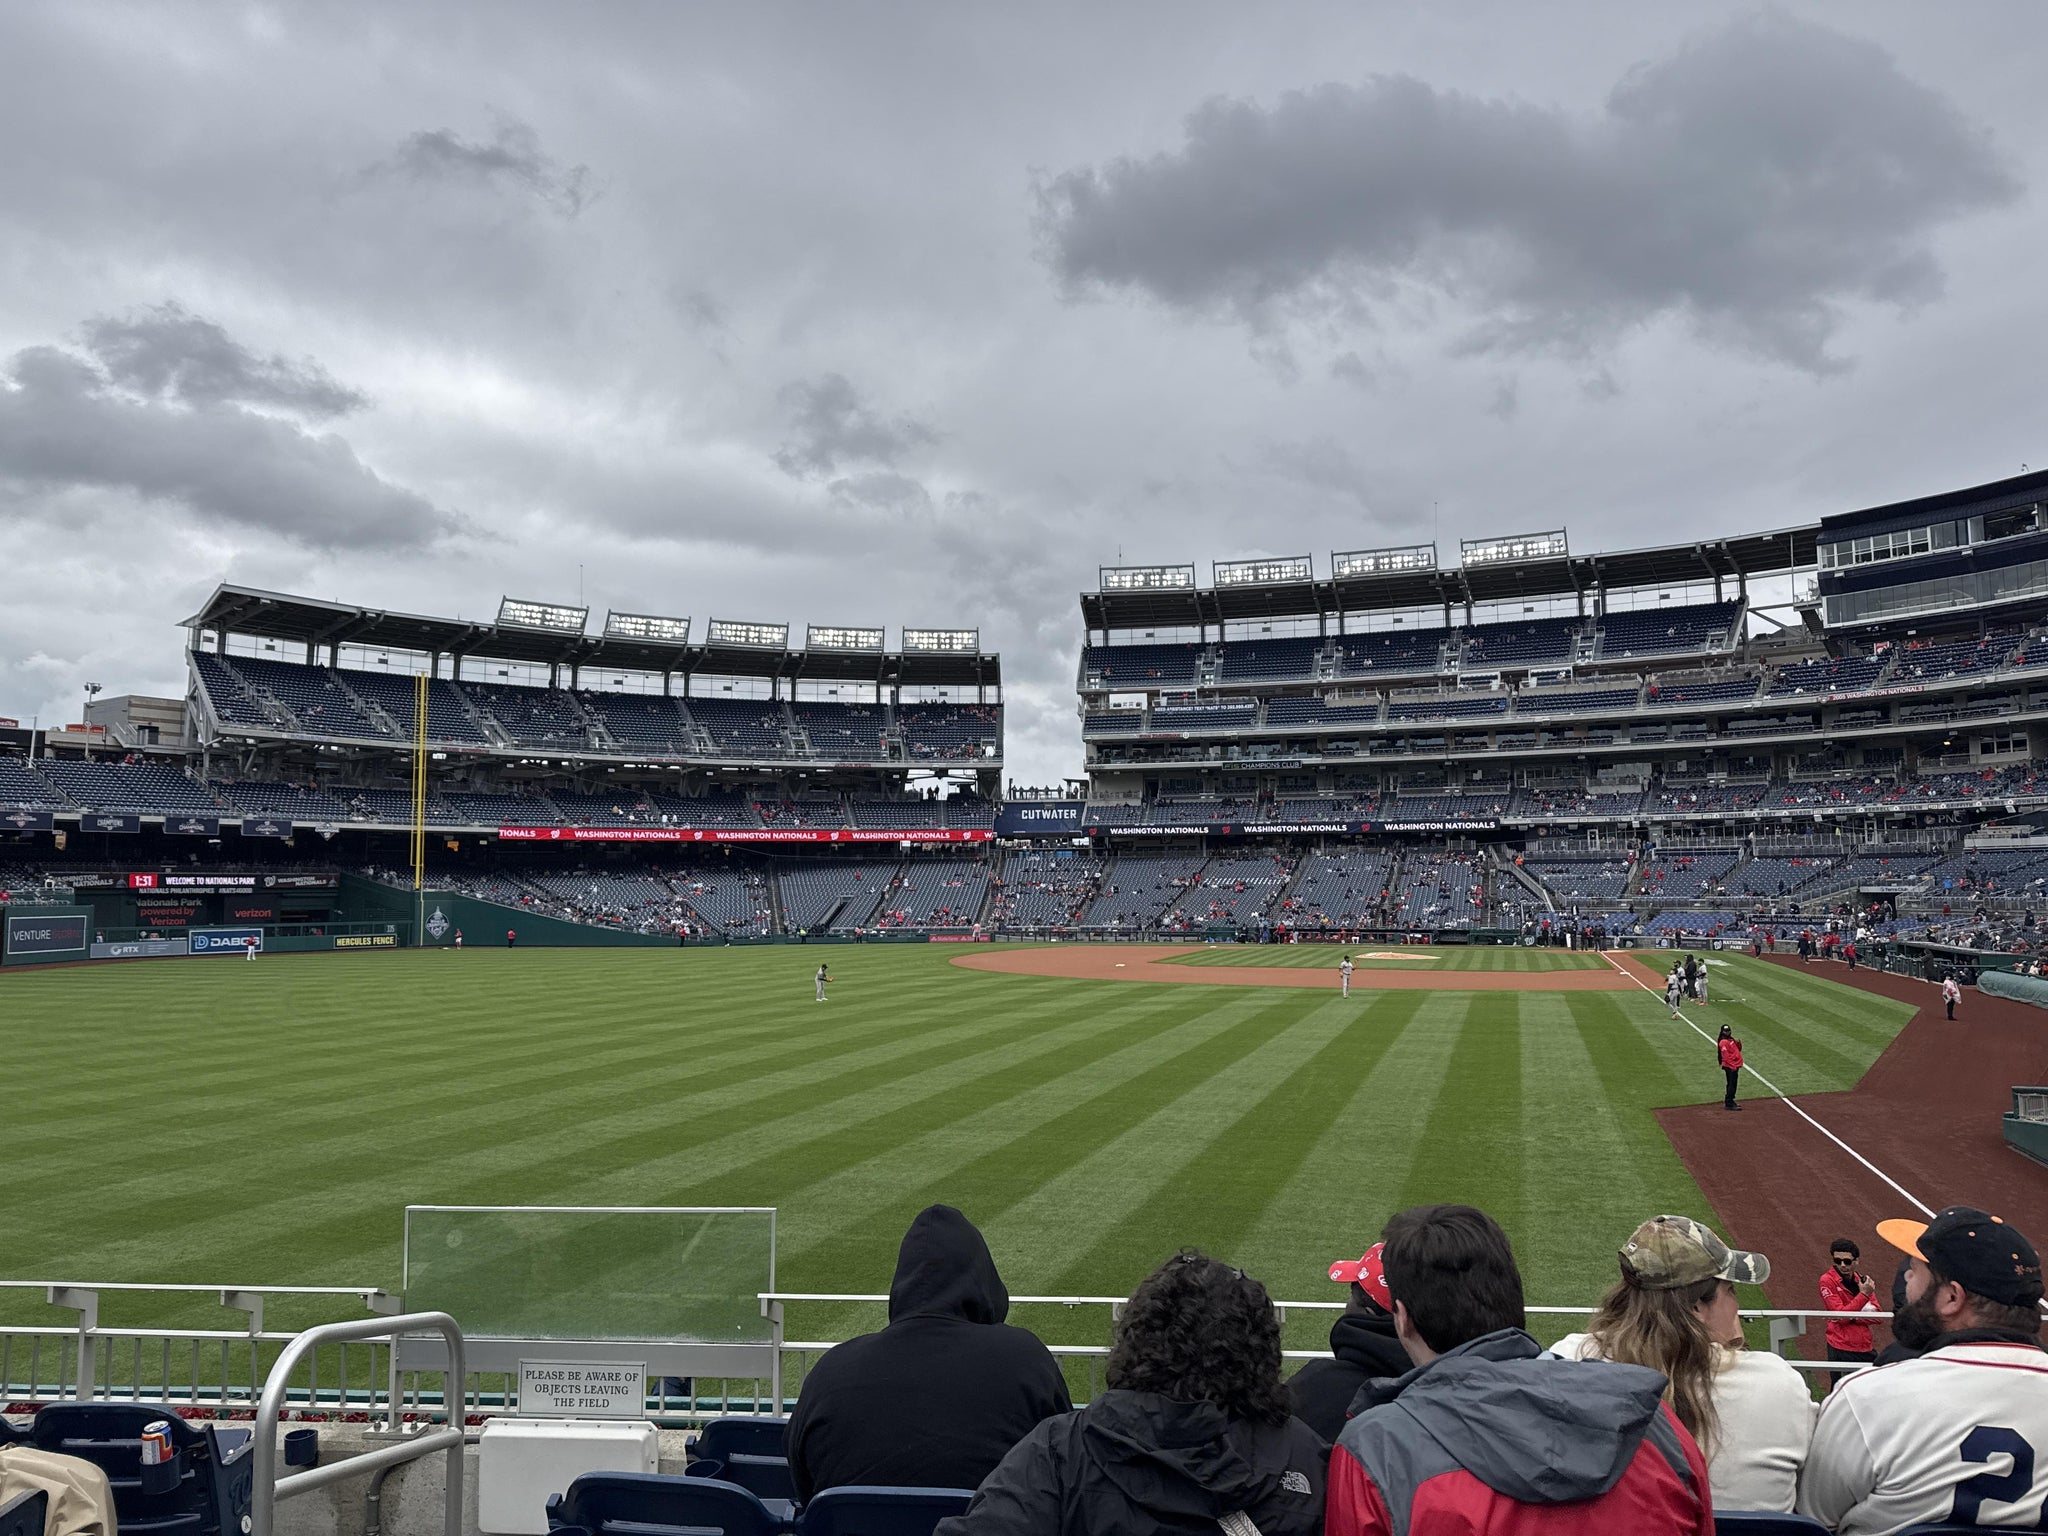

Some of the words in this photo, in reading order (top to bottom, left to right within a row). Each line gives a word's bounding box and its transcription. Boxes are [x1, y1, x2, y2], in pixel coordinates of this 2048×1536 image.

[1846, 690, 1888, 699] WASHINGTON
[1888, 686, 1923, 694] NATIONALS
[1021, 809, 1077, 820] CUTWATER
[1938, 814, 1962, 823] PNC
[1244, 825, 1298, 833] WASHINGTON
[1300, 824, 1347, 832] NATIONALS
[1384, 822, 1444, 831] WASHINGTON
[1445, 821, 1496, 830] NATIONALS
[574, 831, 632, 839] WASHINGTON
[633, 831, 680, 839] NATIONALS
[773, 832, 817, 840] NATIONALS
[852, 832, 905, 840] WASHINGTON
[907, 832, 950, 840] NATIONALS
[1549, 827, 1572, 836] PNC
[73, 879, 114, 887] NATIONALS
[135, 876, 152, 887] 1:31
[165, 877, 195, 886] WELCOME
[196, 877, 205, 885] TO
[205, 877, 238, 886] NATIONALS
[239, 877, 256, 885] PARK
[182, 898, 202, 906] Park
[140, 908, 185, 917] powered
[185, 908, 195, 916] by
[235, 909, 272, 918] verizon
[150, 917, 186, 926] Verizon
[13, 929, 52, 941] VENTURE
[336, 937, 371, 946] HERCULES
[373, 936, 394, 945] FENCE
[525, 1370, 565, 1380] PLEASE
[568, 1371, 582, 1380] BE
[585, 1372, 622, 1381] AWARE
[624, 1372, 639, 1382] OF
[534, 1384, 581, 1396] OBJECTS
[584, 1385, 629, 1396] LEAVING
[553, 1398, 575, 1407] THE
[578, 1398, 610, 1408] FIELD
[1284, 1471, 1299, 1479] THE
[1949, 1426, 2048, 1530] 2
[1279, 1476, 1299, 1486] ORTH
